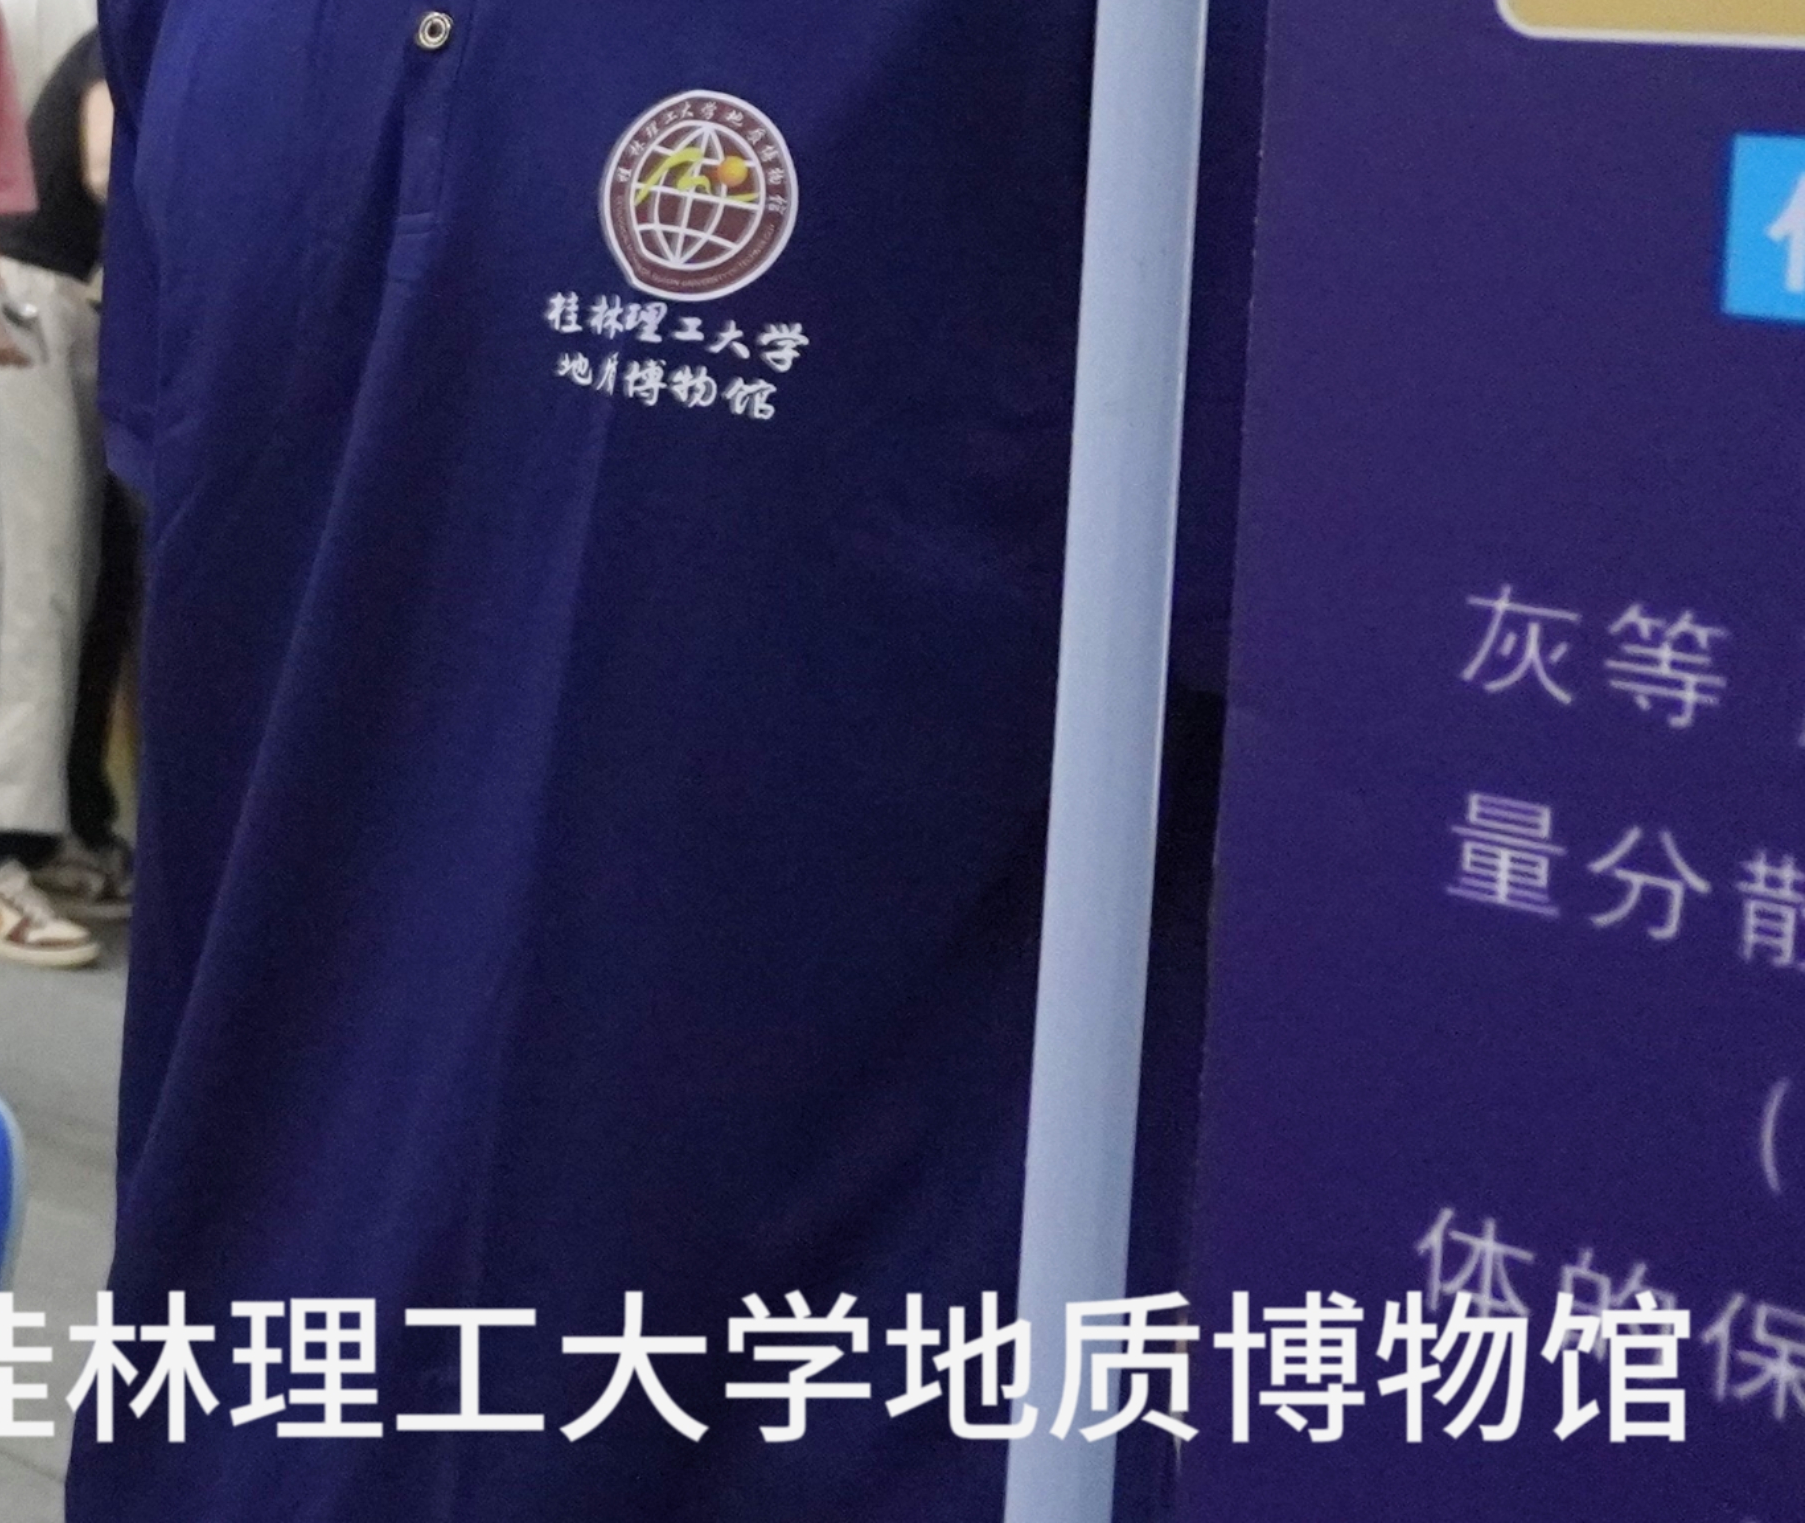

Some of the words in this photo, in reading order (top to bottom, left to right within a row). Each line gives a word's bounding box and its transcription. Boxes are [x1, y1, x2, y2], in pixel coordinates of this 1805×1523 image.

[545, 291, 810, 373] 桂林理工大学
[1461, 584, 1729, 729] 灰等
